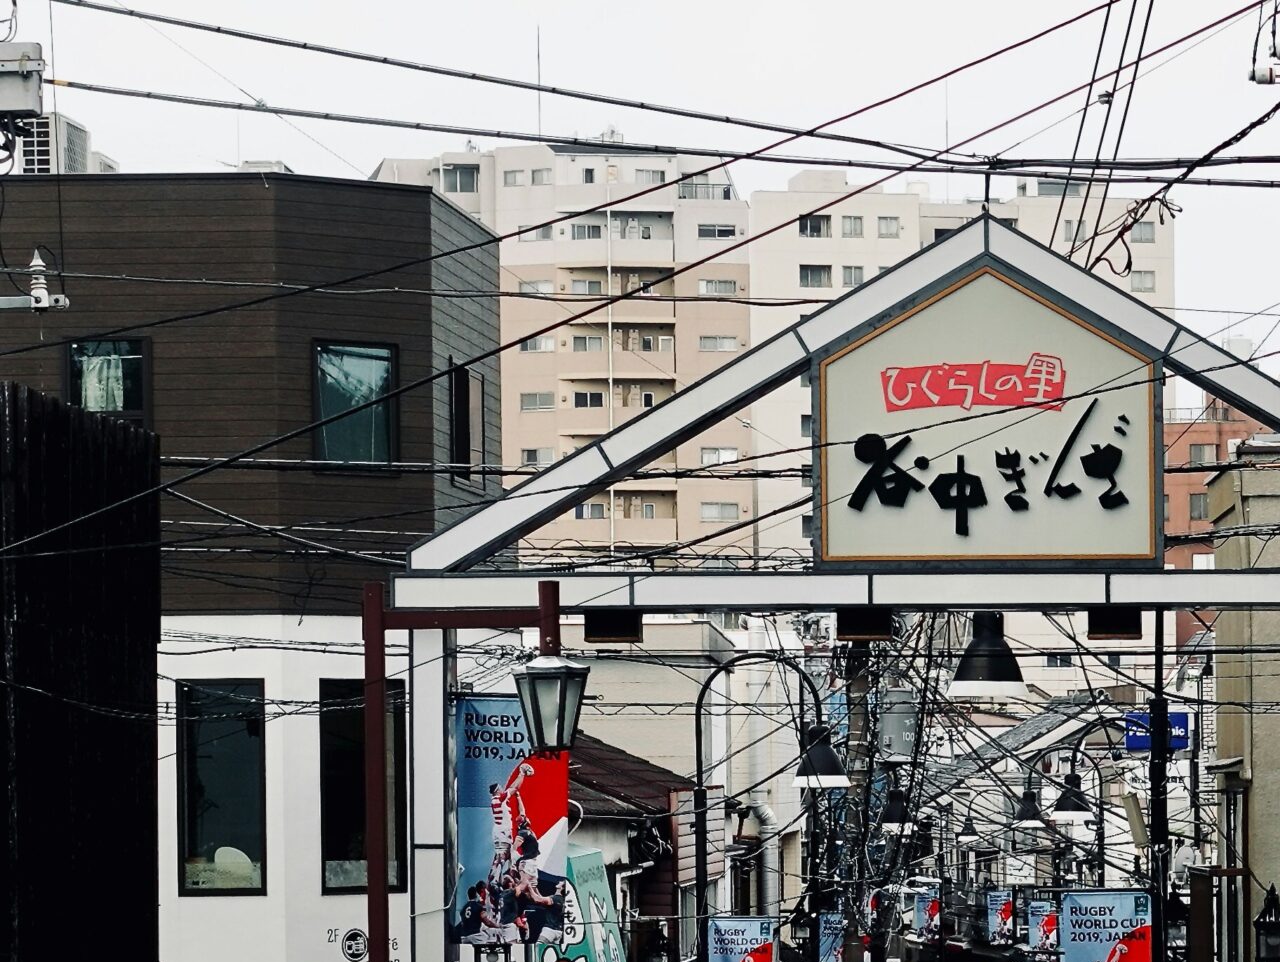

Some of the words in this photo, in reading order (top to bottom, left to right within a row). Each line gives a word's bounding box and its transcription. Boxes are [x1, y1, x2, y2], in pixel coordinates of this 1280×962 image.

[886, 354, 1062, 410] ひぐらしの里
[848, 398, 1130, 536] 谷中ぎんざ
[464, 713, 522, 727] RUGBY
[464, 731, 525, 744] WORLD
[464, 746, 504, 761] 2019,
[1070, 906, 1115, 916] RUGBY
[1070, 918, 1119, 929] WORLD
[1120, 918, 1147, 929] CUP
[327, 929, 339, 943] 2F
[713, 928, 746, 937] RUGBY
[1071, 932, 1102, 943] 2019,
[1104, 931, 1147, 942] JAPAN
[713, 937, 748, 946] WORLD
[749, 937, 769, 946] CUP
[738, 947, 770, 955] JAPAN
